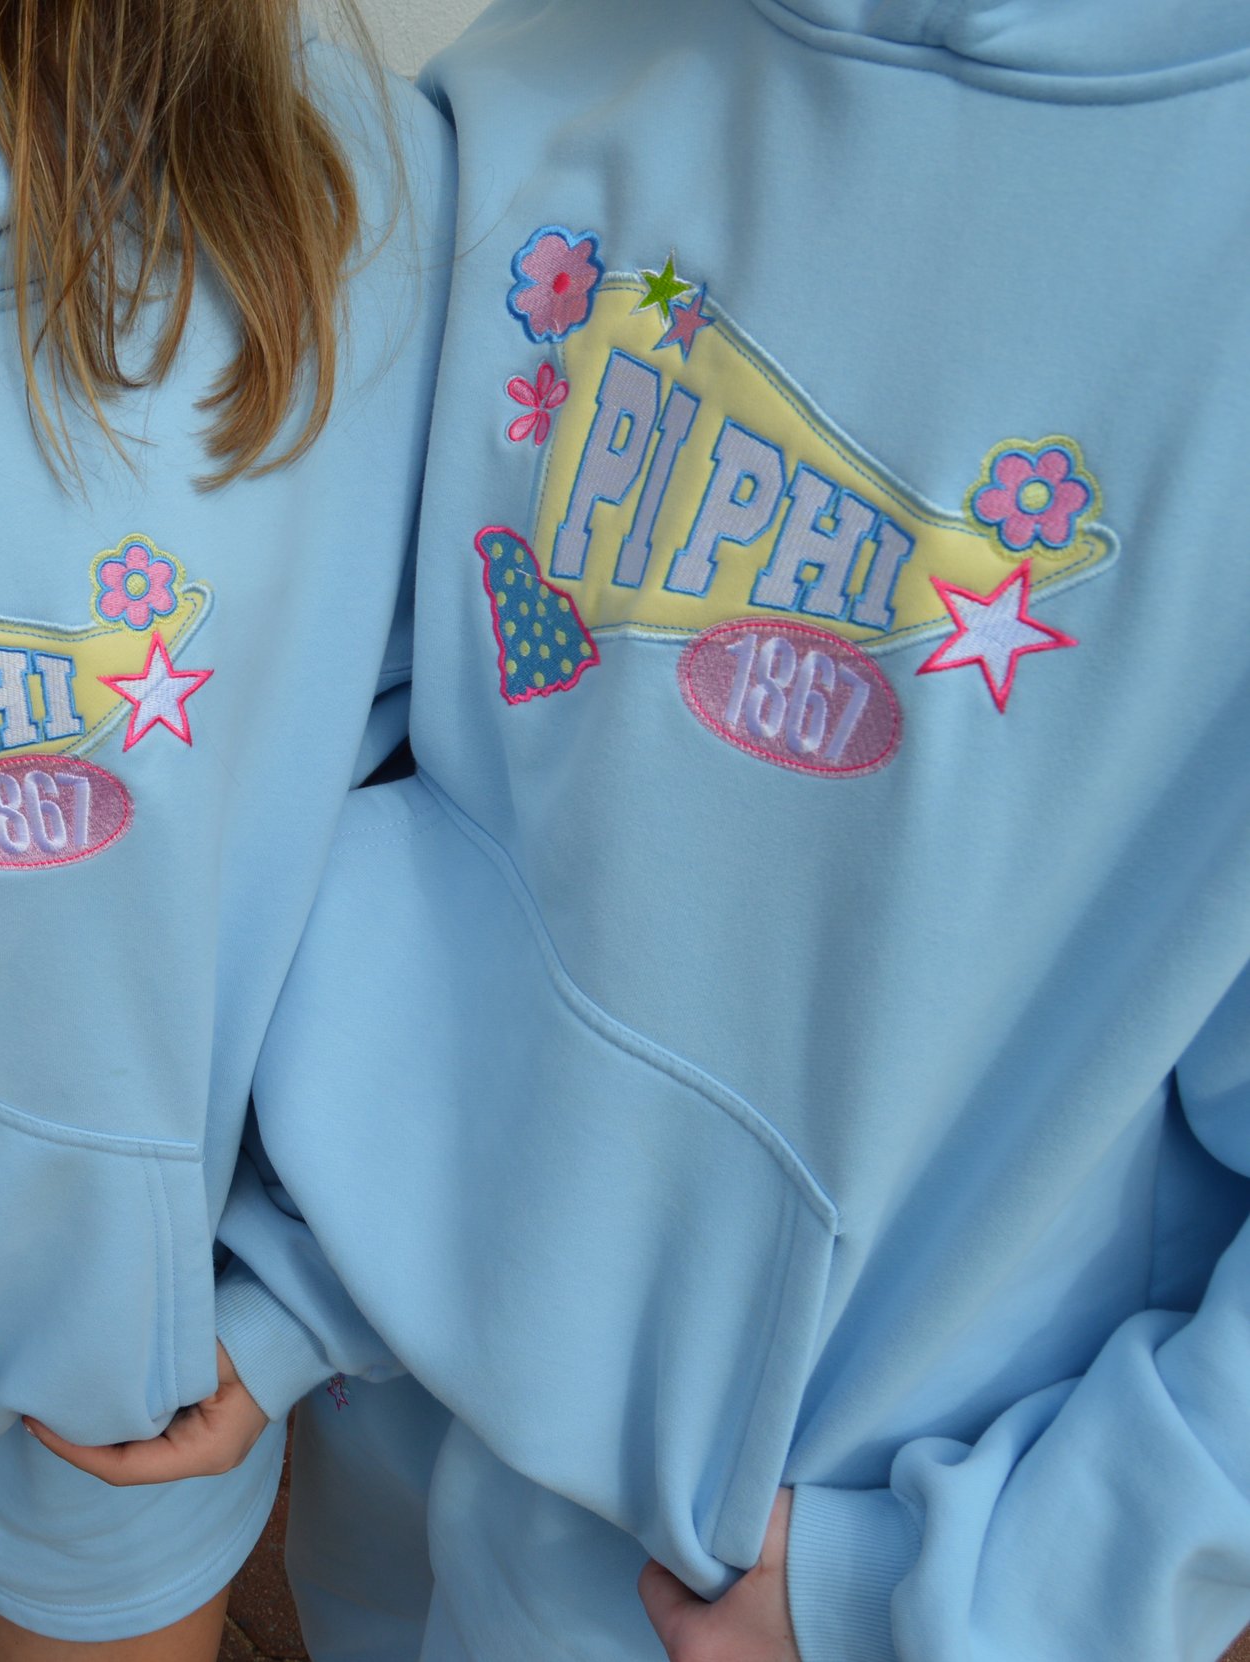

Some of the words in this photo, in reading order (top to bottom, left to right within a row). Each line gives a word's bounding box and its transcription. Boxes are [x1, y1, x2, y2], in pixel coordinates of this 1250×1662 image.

[549, 347, 701, 589] PI
[663, 416, 916, 632] PHI
[724, 633, 871, 763] 1867
